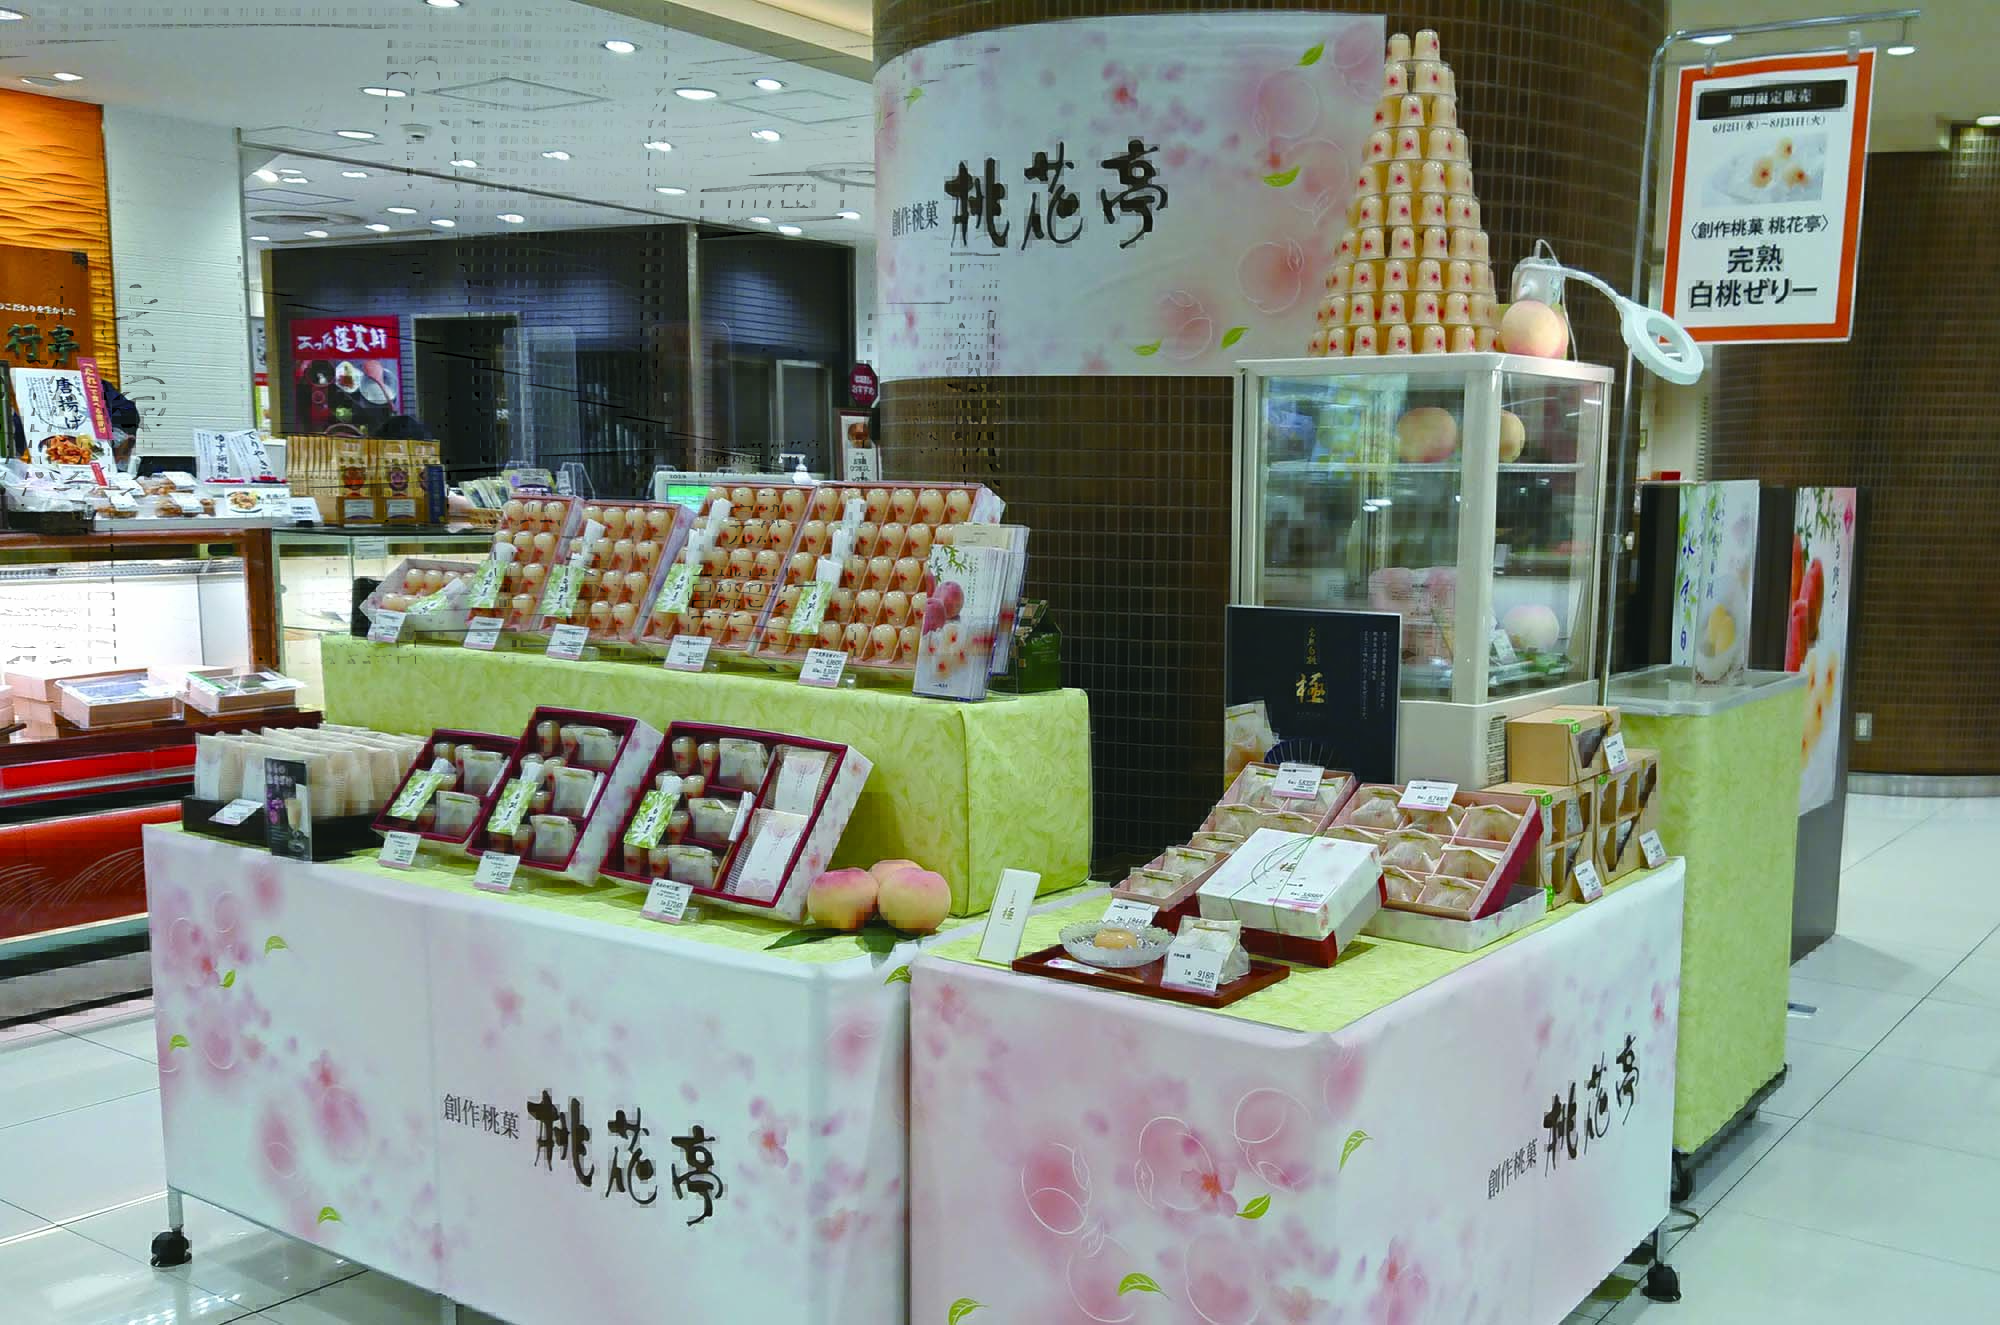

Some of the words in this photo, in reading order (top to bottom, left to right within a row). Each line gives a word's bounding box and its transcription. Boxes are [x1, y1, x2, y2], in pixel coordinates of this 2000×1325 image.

[892, 200, 939, 237] 創作桃菓
[944, 139, 1169, 251] 桃花亭
[1726, 243, 1784, 274] 完熟
[1689, 277, 1819, 309] 白桃ぜりー
[56, 376, 81, 431] 唐揚げ
[1295, 672, 1326, 704] 極
[1487, 1138, 1538, 1200] 創作桃菓
[1543, 1034, 1640, 1178] 桃花亭
[443, 1093, 520, 1140] 創作桃菓
[527, 1089, 724, 1227] 桃花亭
